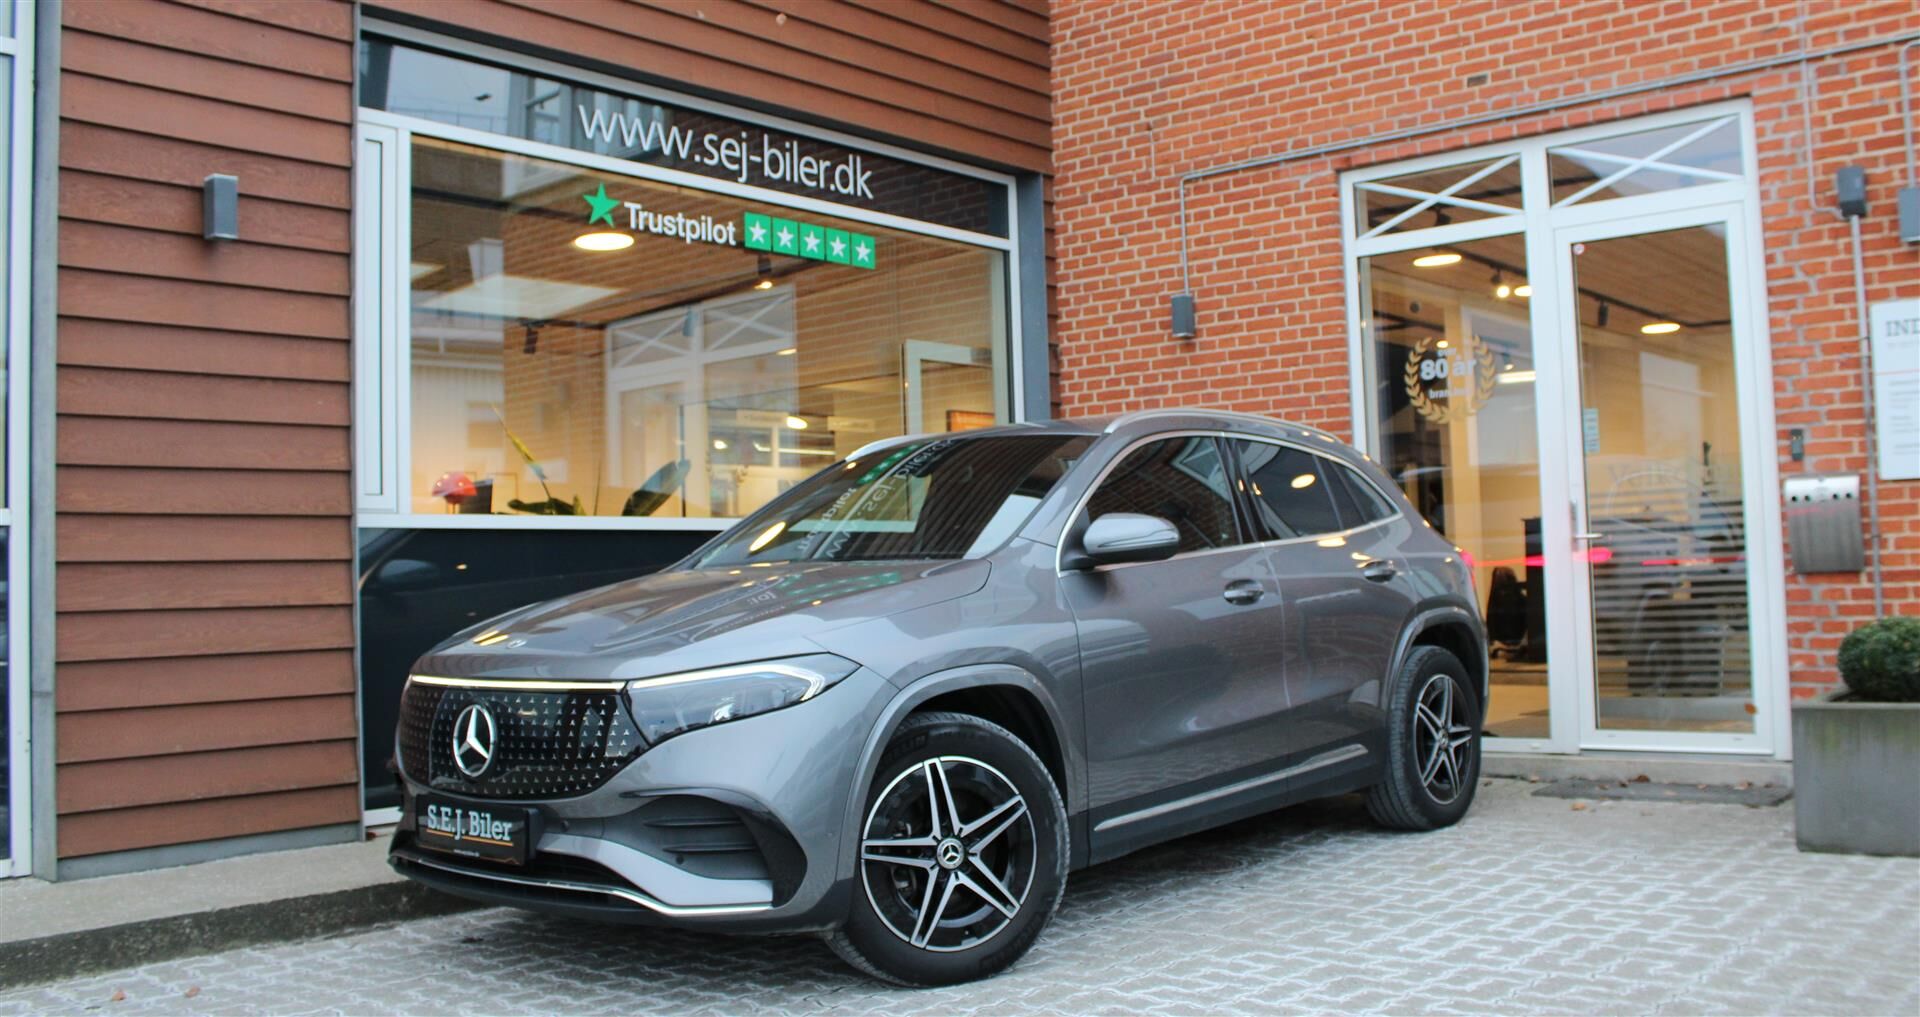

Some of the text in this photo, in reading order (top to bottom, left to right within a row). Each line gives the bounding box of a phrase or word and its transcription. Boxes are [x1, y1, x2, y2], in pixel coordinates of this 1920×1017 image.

[578, 104, 874, 199] www.sej-biler.dk
[623, 201, 737, 246] Trustpilot
[1420, 359, 1449, 381] 80
[427, 804, 513, 841] S.E.J. Biler
